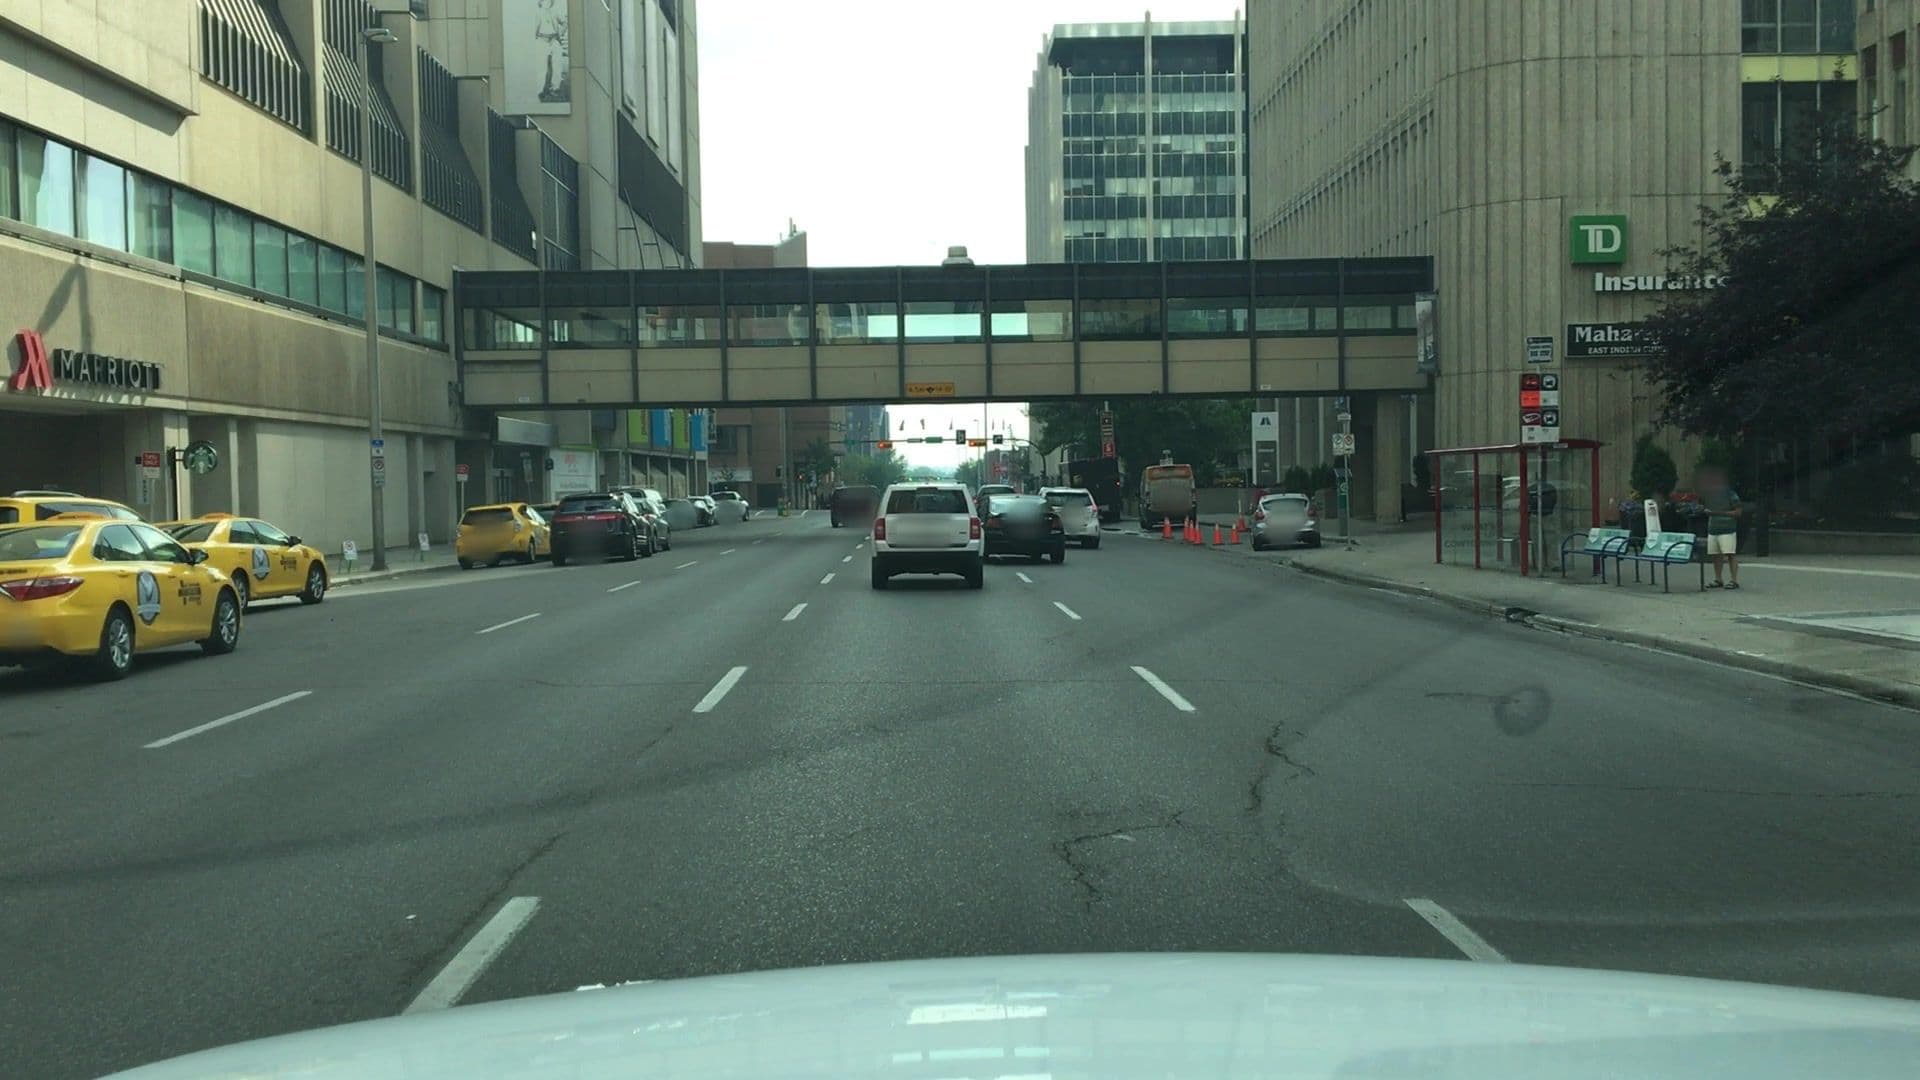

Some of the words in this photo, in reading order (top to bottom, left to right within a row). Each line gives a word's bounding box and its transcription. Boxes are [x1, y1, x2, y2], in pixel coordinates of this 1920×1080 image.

[1579, 224, 1622, 254] TD
[1587, 345, 1609, 355] EAST
[58, 349, 164, 392] MARRIOTT
